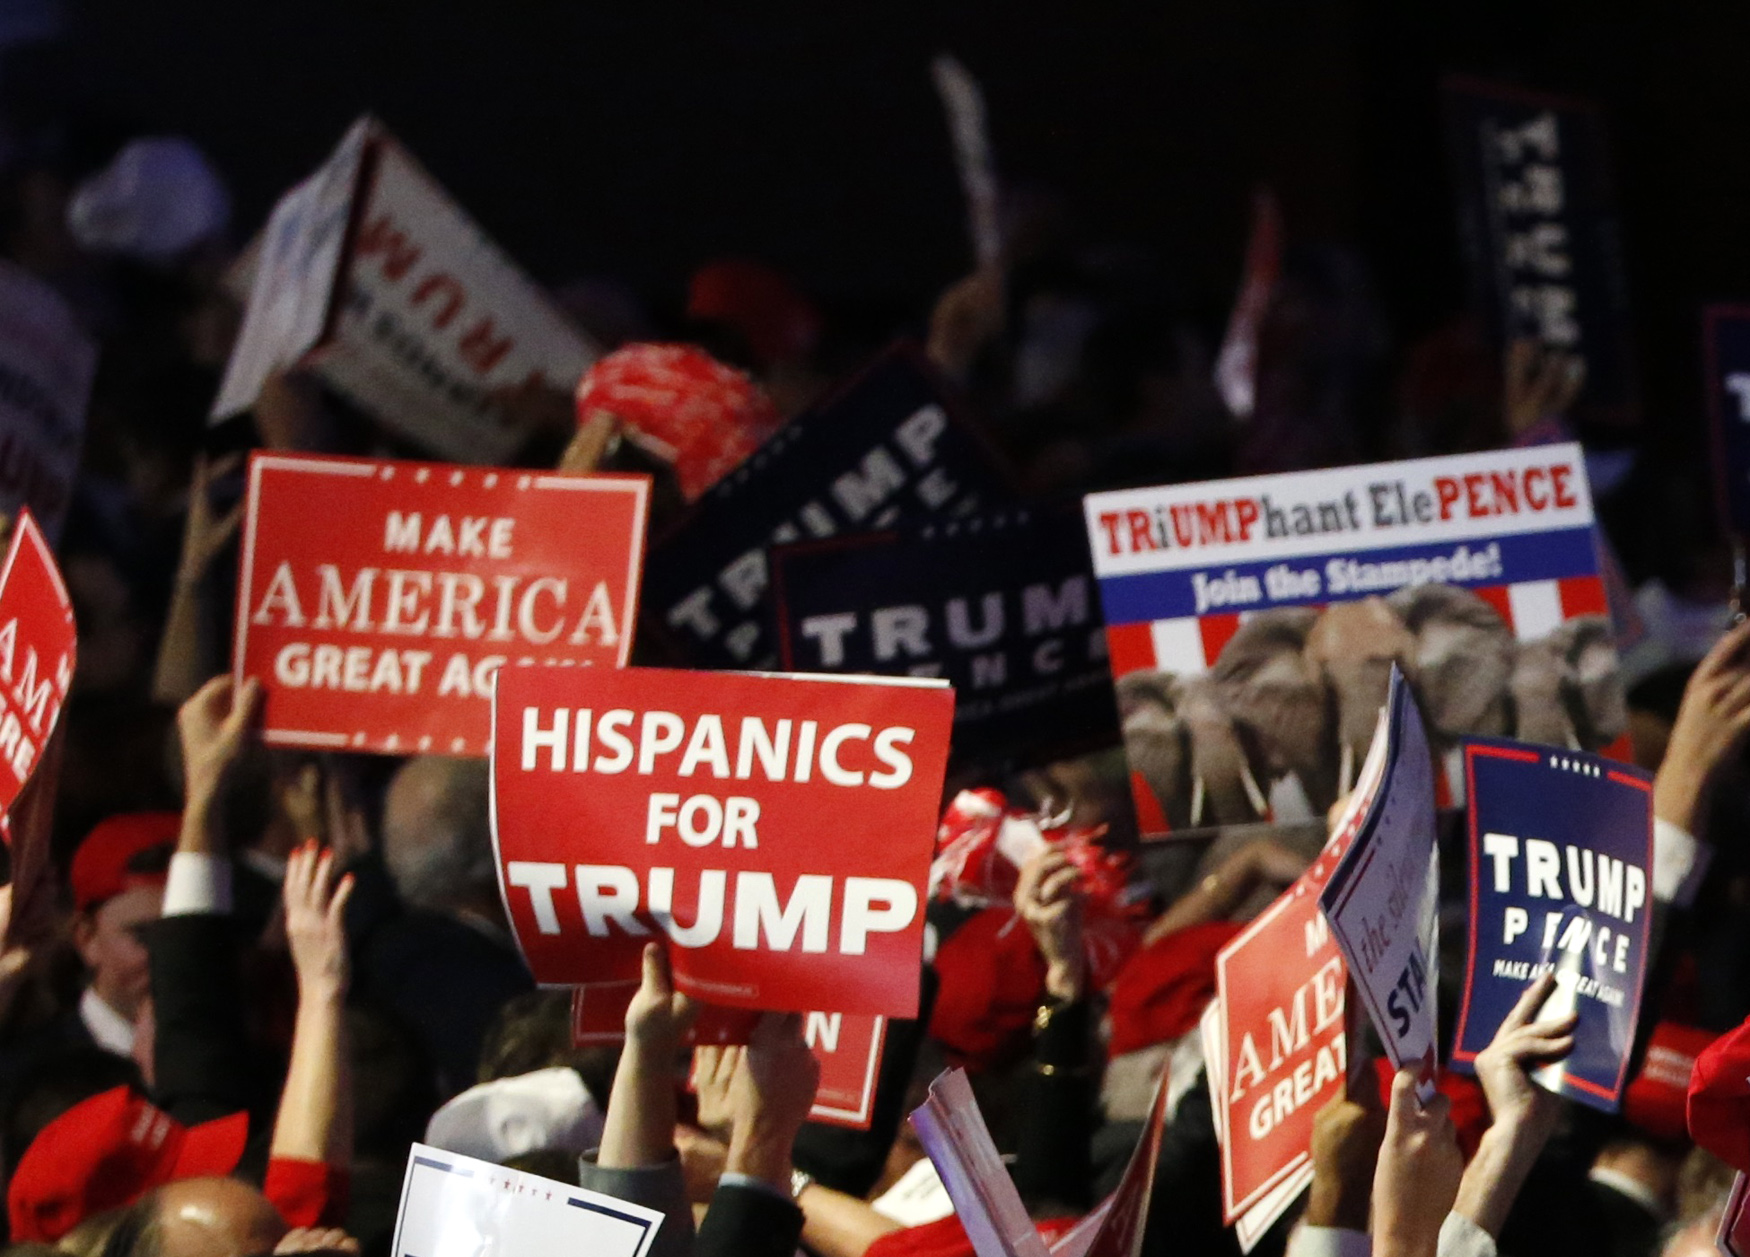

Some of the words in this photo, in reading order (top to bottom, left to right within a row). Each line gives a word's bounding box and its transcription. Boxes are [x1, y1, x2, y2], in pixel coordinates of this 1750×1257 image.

[383, 509, 517, 559] MAKE
[1100, 493, 1361, 557] TRiUMPhant
[1369, 465, 1578, 528] ElePENCE
[252, 559, 620, 648] AMERICA
[1190, 560, 1263, 615] Join
[1265, 561, 1322, 601] the
[1325, 541, 1503, 594] Stampede!
[801, 574, 1090, 668] TRUM
[273, 641, 434, 696] GREAT
[521, 706, 916, 790] HISPANICS
[645, 792, 761, 850] FOR
[507, 860, 918, 955] TRUMP
[1483, 832, 1647, 924] TRUMP
[1492, 959, 1530, 981] MAKE
